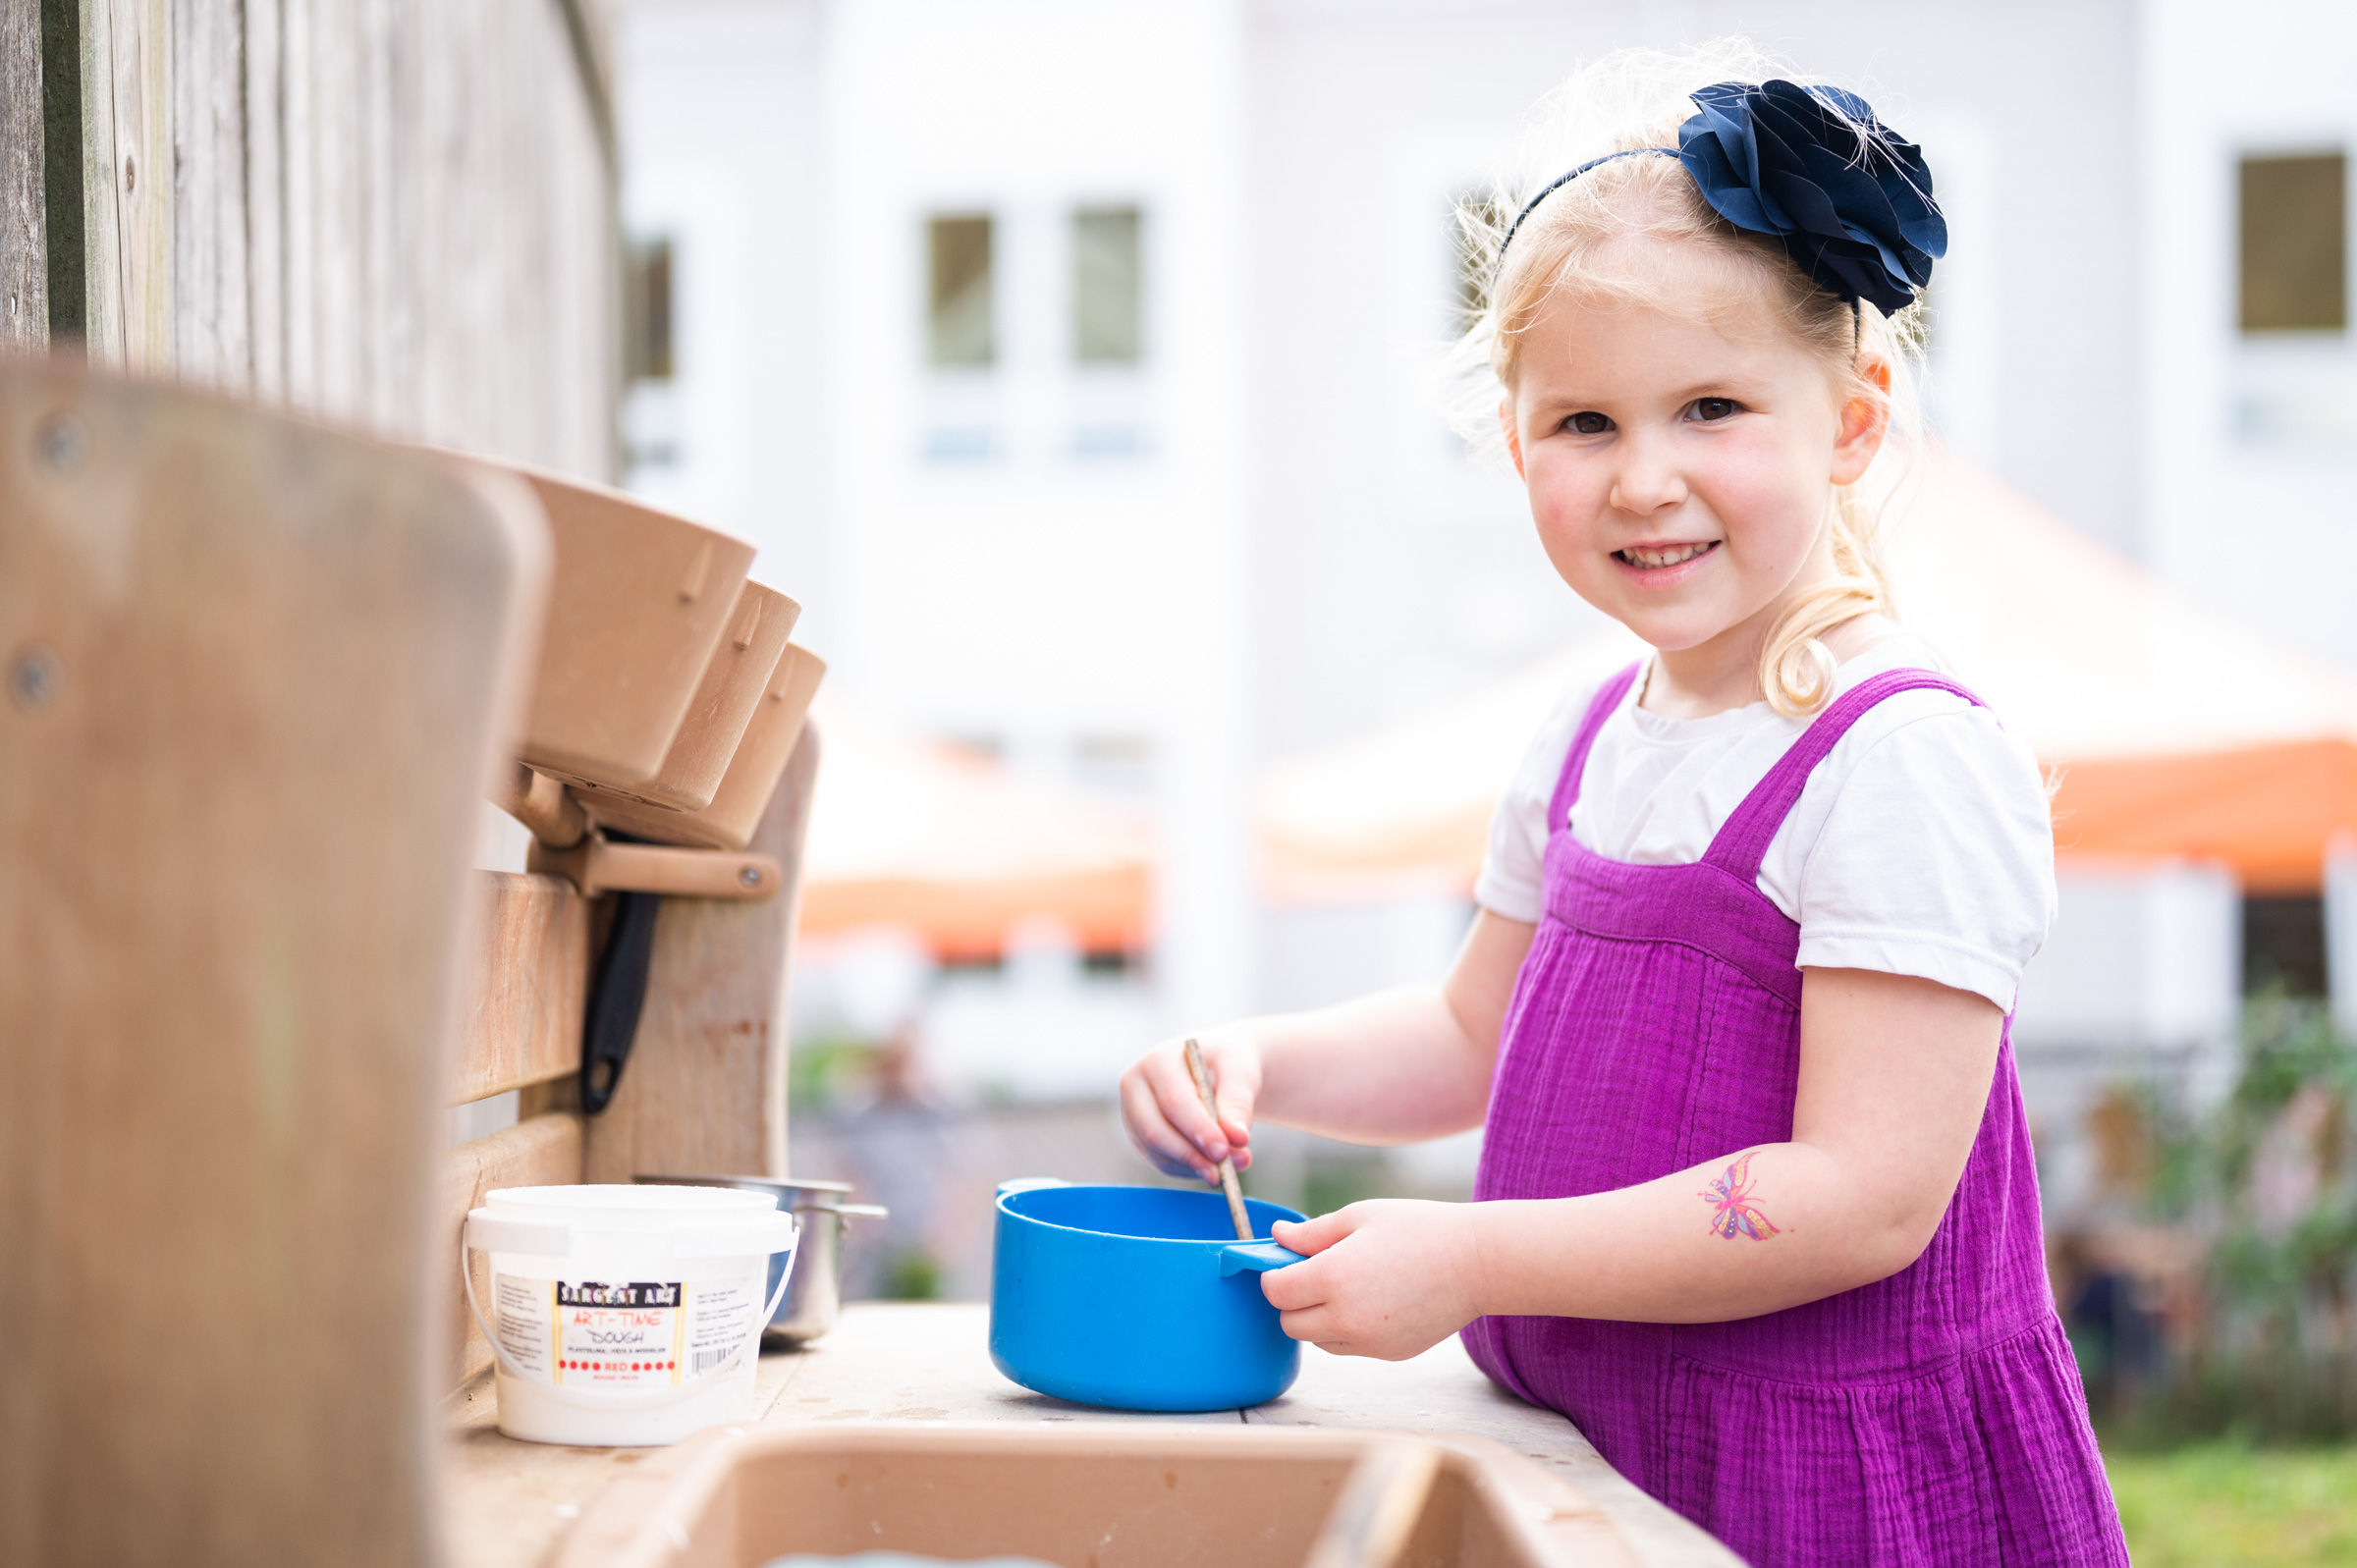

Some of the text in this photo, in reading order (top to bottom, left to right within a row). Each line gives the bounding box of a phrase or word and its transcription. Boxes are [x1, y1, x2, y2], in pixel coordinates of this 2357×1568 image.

[644, 1285, 678, 1306] ART
[574, 1311, 665, 1326] ART-TIME
[586, 1329, 644, 1344] DOUGH
[604, 1362, 628, 1372] RED
